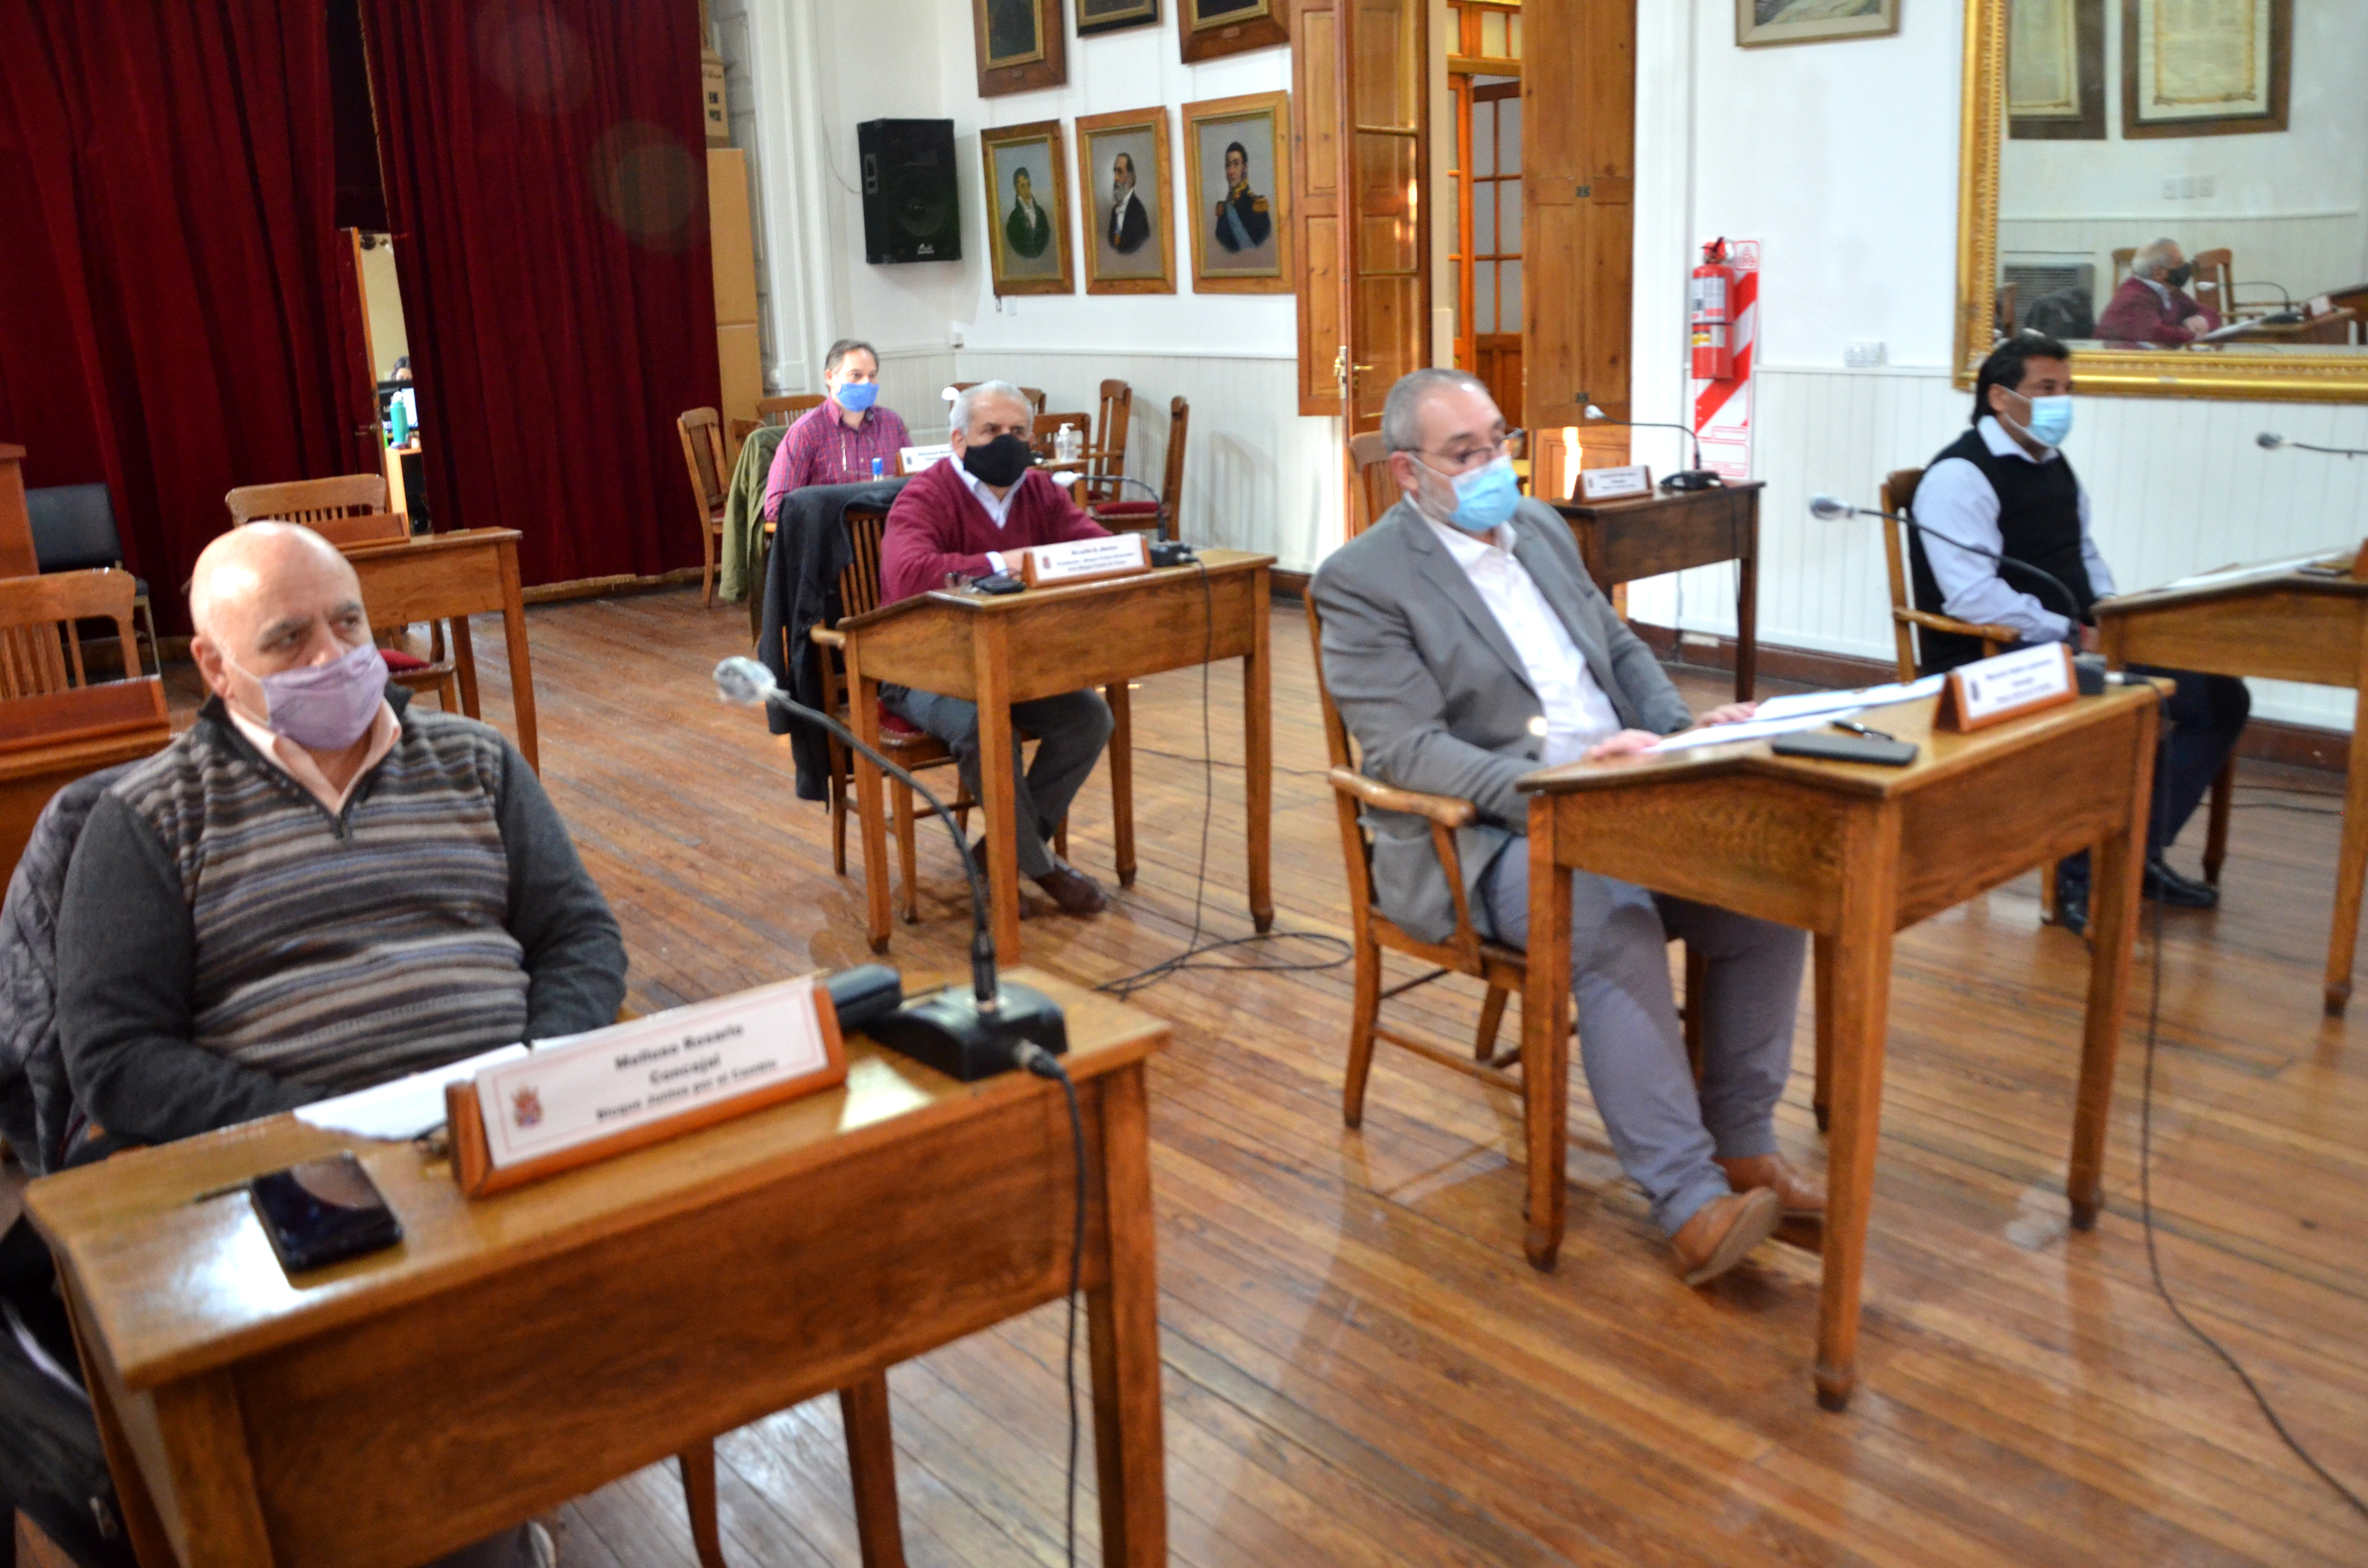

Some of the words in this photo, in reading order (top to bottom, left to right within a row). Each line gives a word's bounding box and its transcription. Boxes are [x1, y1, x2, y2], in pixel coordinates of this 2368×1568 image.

[684, 1024, 743, 1050] Rosario
[650, 1053, 720, 1084] Concejal
[694, 1079, 713, 1096] por
[717, 1072, 728, 1085] el
